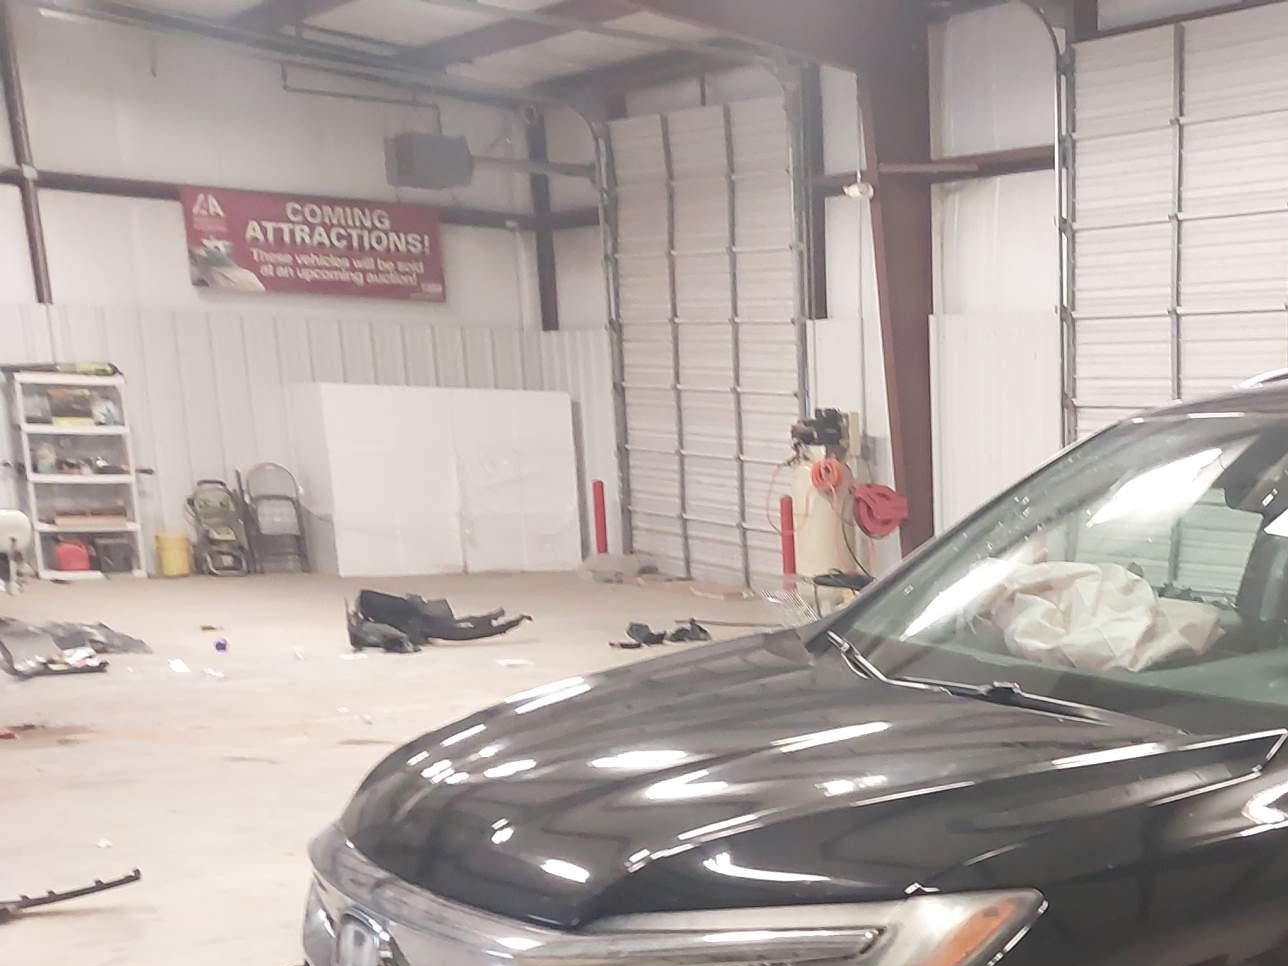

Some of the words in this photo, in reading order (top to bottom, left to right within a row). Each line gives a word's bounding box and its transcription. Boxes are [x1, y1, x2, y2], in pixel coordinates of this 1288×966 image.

[285, 201, 391, 231] COMING
[244, 219, 431, 256] ATTRACTIONS!
[250, 248, 293, 265] These
[295, 252, 350, 268] vehicles
[352, 257, 376, 270] will
[377, 257, 396, 272] be
[396, 261, 425, 274] sold
[260, 264, 275, 277] at
[276, 266, 295, 279] an
[296, 267, 365, 286] upcoming
